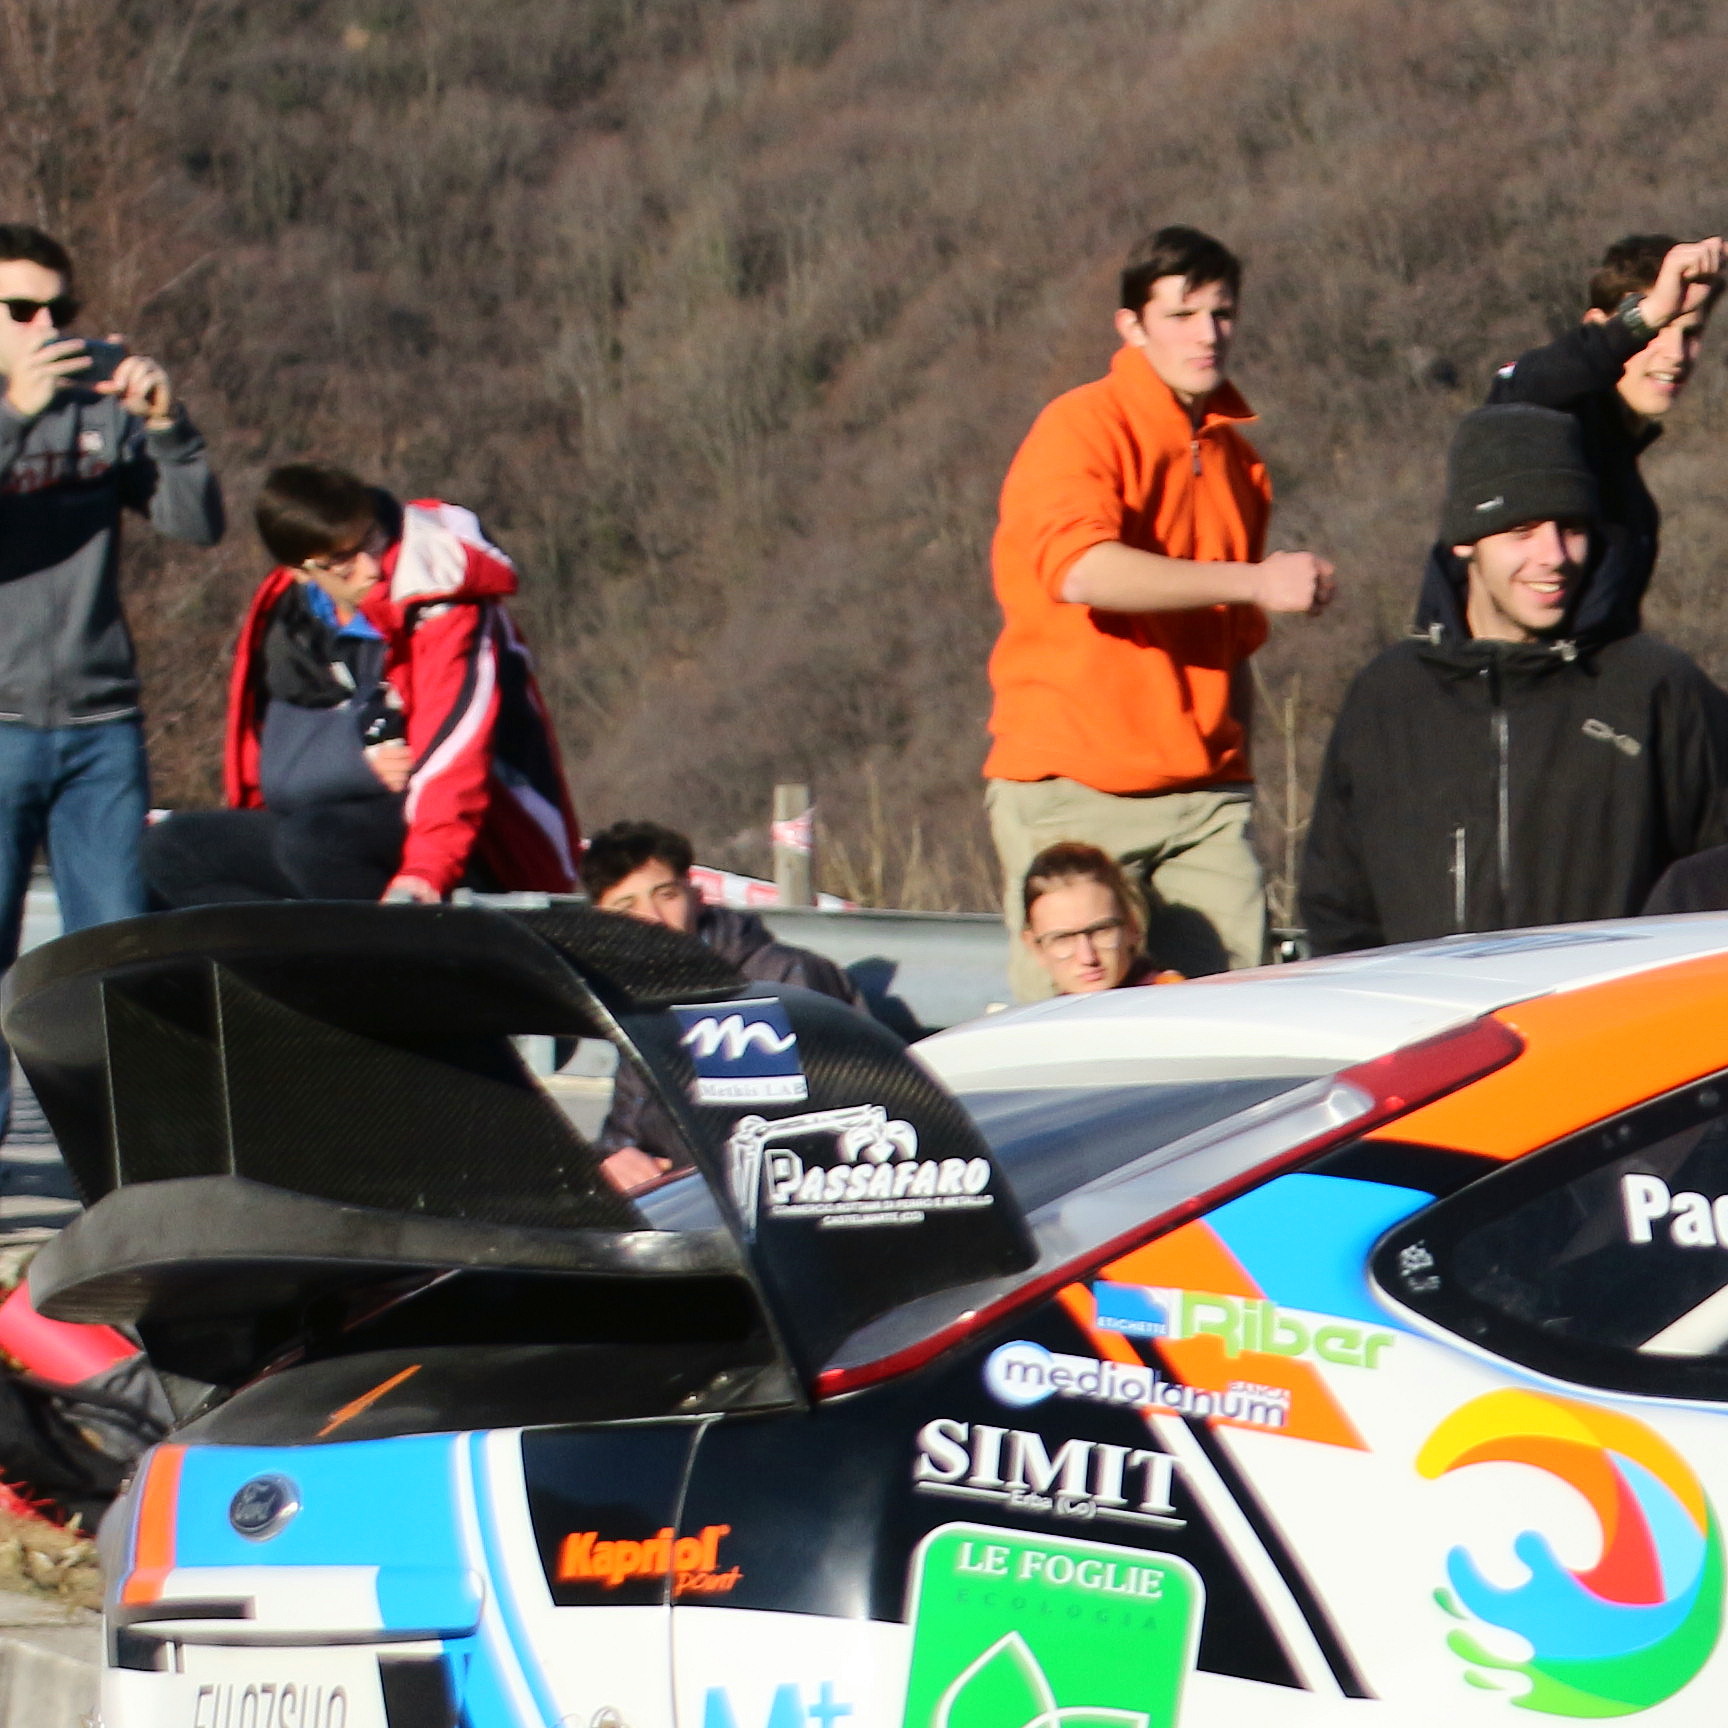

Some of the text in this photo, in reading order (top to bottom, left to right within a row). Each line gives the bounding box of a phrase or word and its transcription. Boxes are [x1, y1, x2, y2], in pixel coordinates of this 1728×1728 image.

[765, 1149, 991, 1204] PASSAFARO
[1181, 1291, 1396, 1370] Riber
[1003, 1354, 1287, 1428] mediolanum
[918, 1418, 1178, 1514] SIMIT
[559, 1525, 732, 1586] Kapriol
[957, 1540, 1166, 1599] LE FOGLIE
[957, 1587, 1159, 1632] ECOLOGIA
